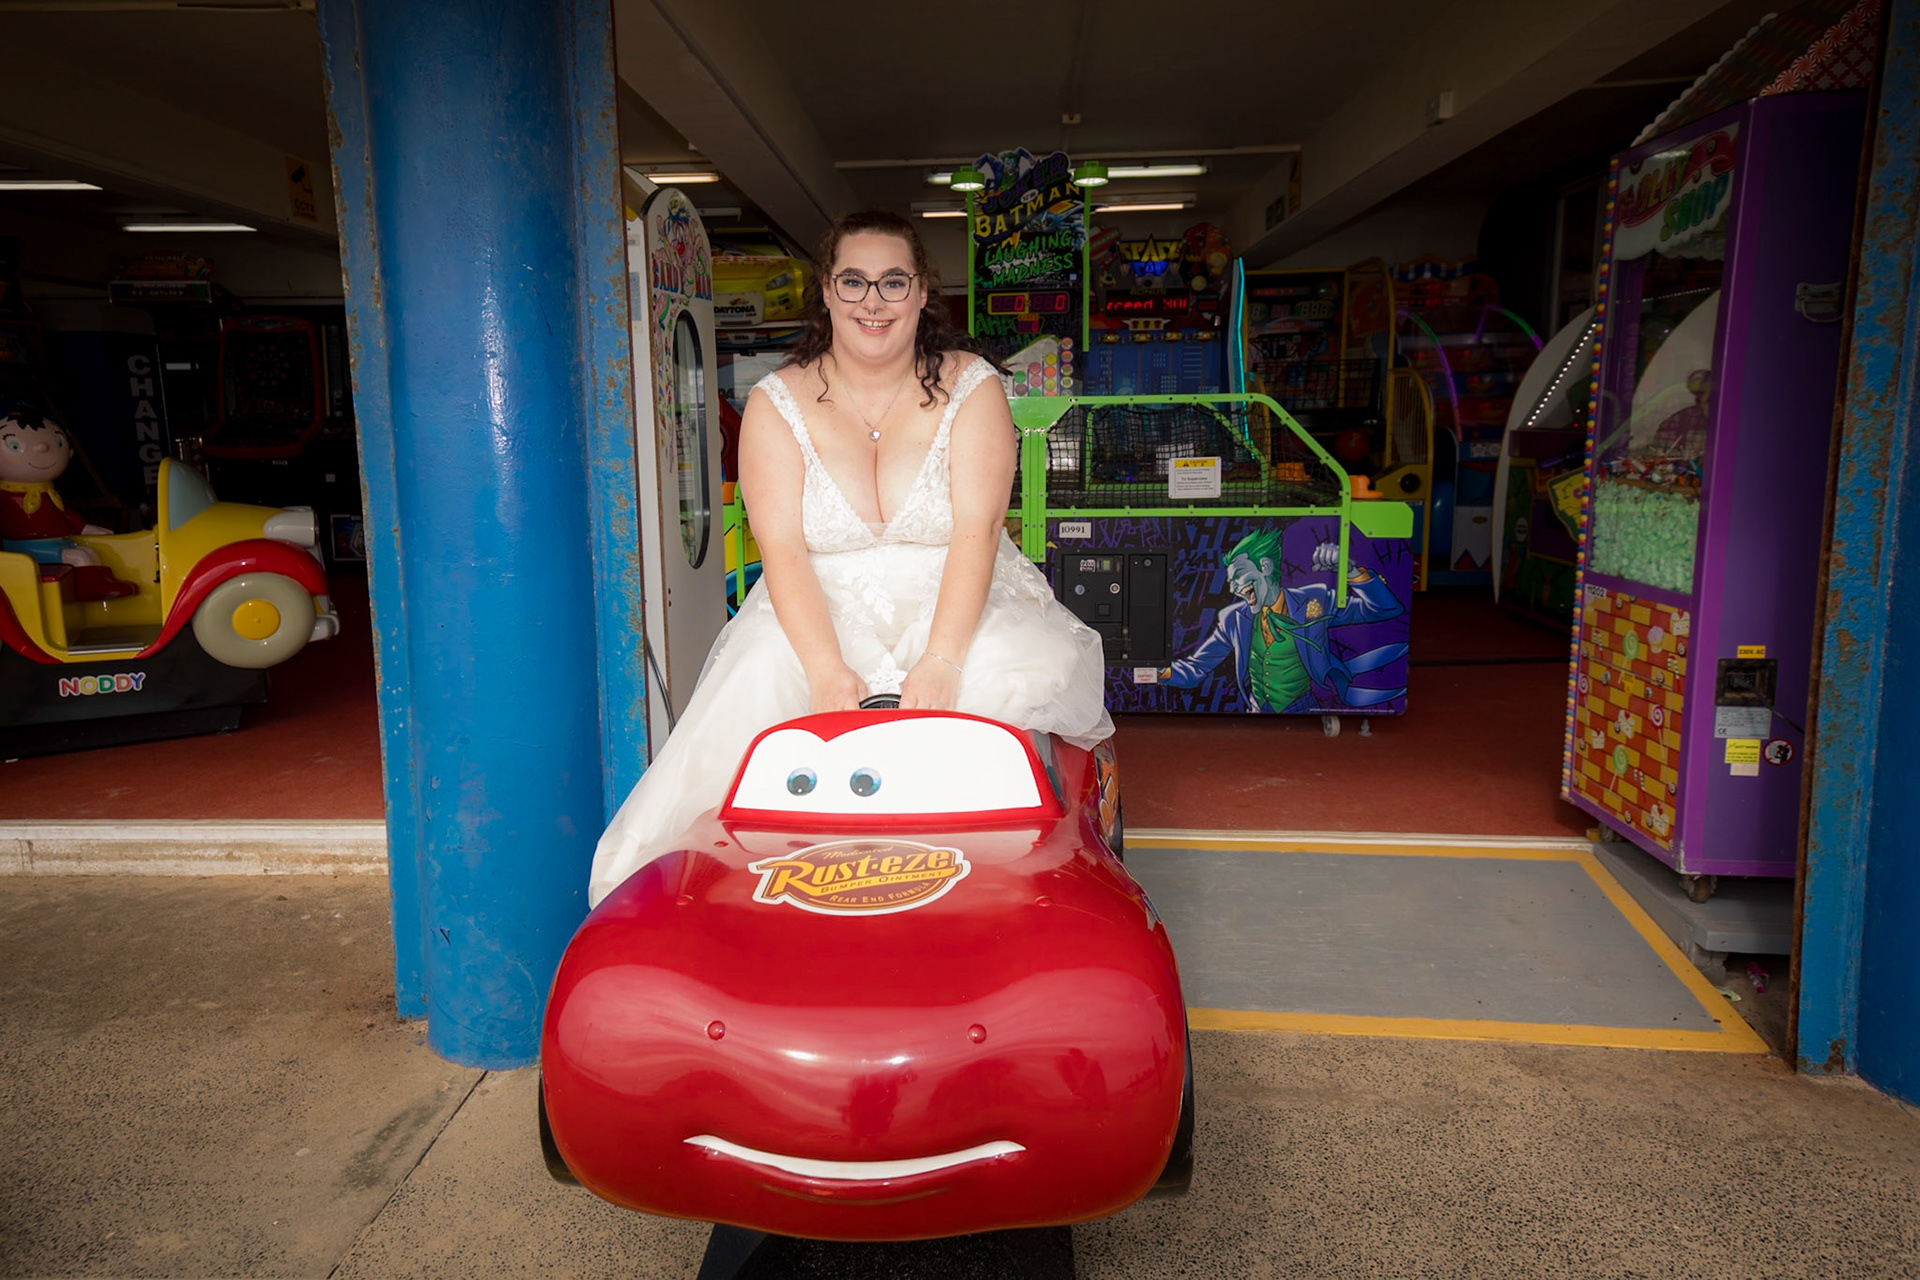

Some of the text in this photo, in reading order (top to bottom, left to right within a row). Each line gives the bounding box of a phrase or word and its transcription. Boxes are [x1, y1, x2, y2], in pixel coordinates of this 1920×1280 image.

[983, 152, 1068, 211] JOKER
[975, 182, 1081, 238] BATMAN
[1660, 172, 1730, 241] SHOP
[984, 229, 1073, 267] LAUGHING
[992, 252, 1074, 286] MADNESS
[714, 305, 755, 314] DAYTONA
[127, 354, 162, 486] CHANGE
[59, 672, 146, 697] NODDY
[820, 871, 943, 893] BUMPER OINTMENT
[829, 881, 932, 904] REAR END FORMULA
